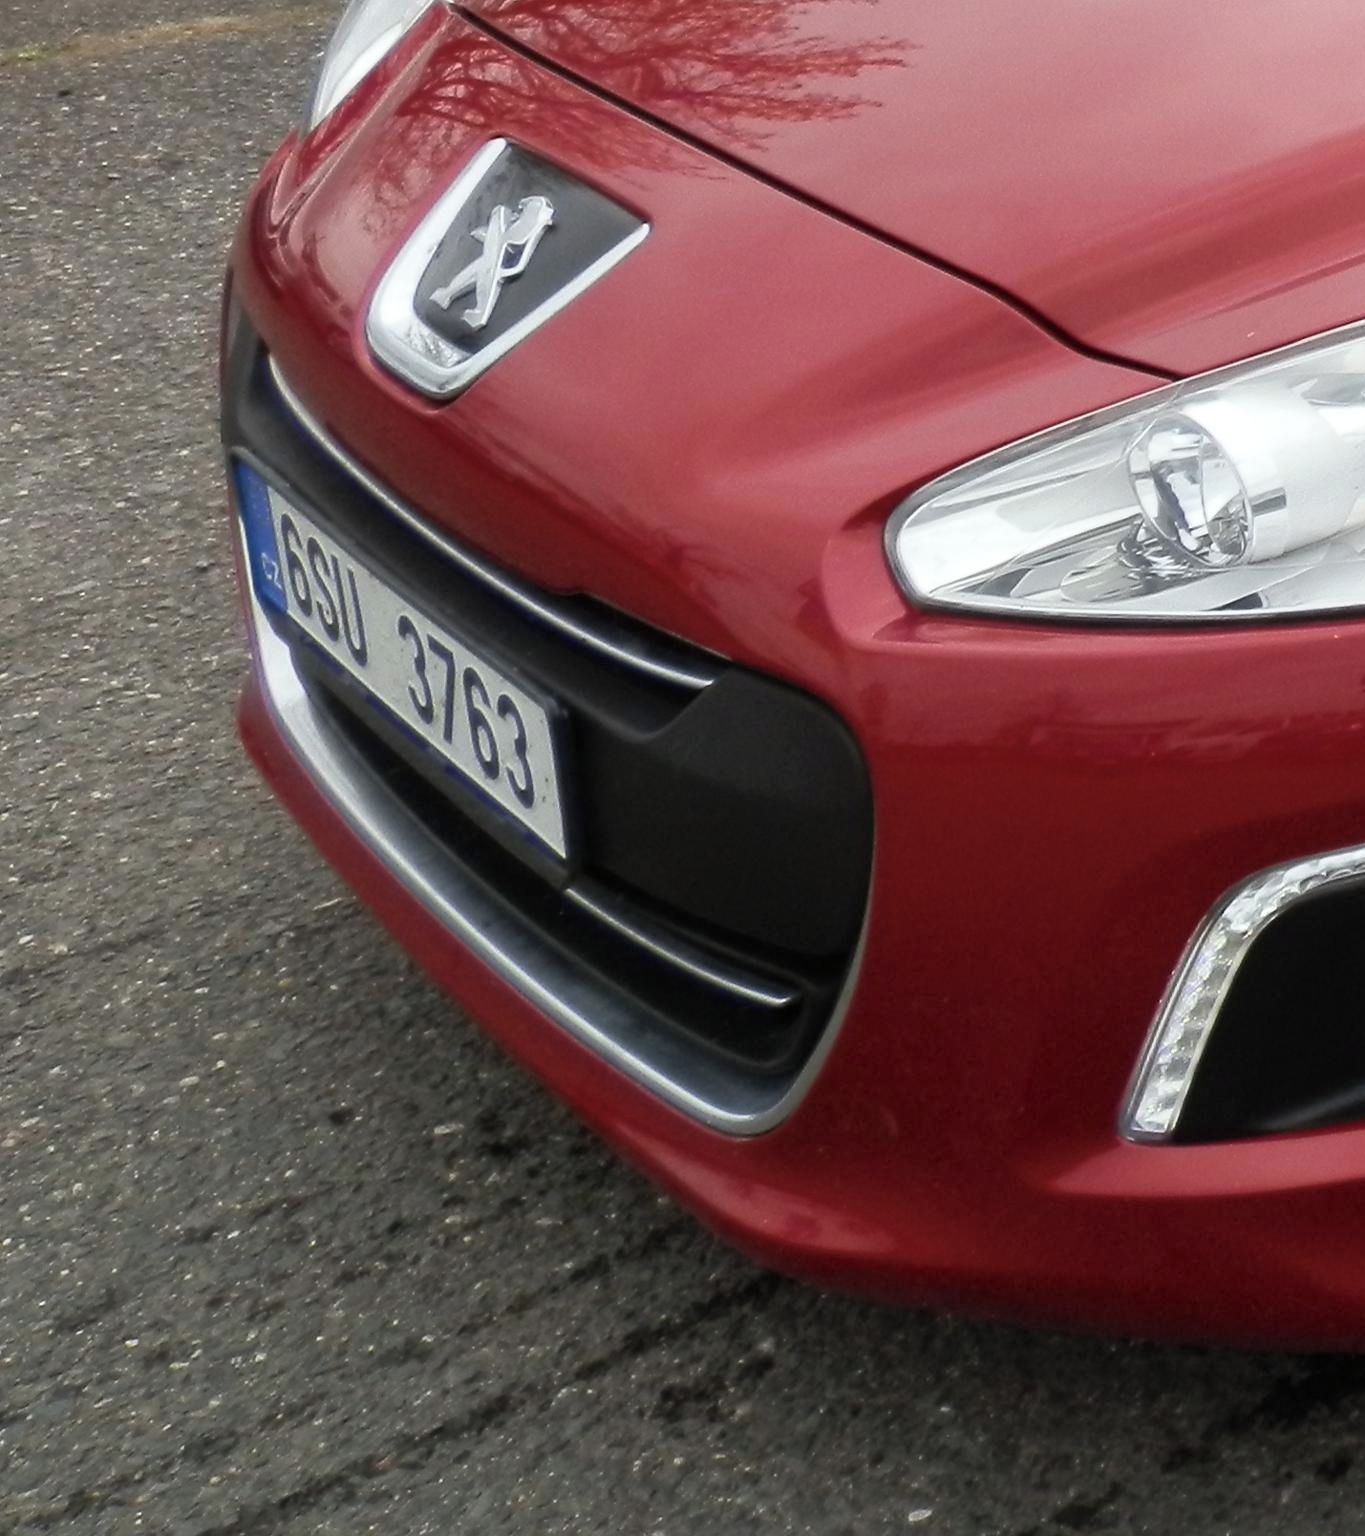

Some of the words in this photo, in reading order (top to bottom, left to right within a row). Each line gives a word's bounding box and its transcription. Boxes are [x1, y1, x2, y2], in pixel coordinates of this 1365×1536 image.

[261, 552, 283, 590] CZ
[281, 513, 368, 667] 6SU
[398, 615, 535, 809] 3763
